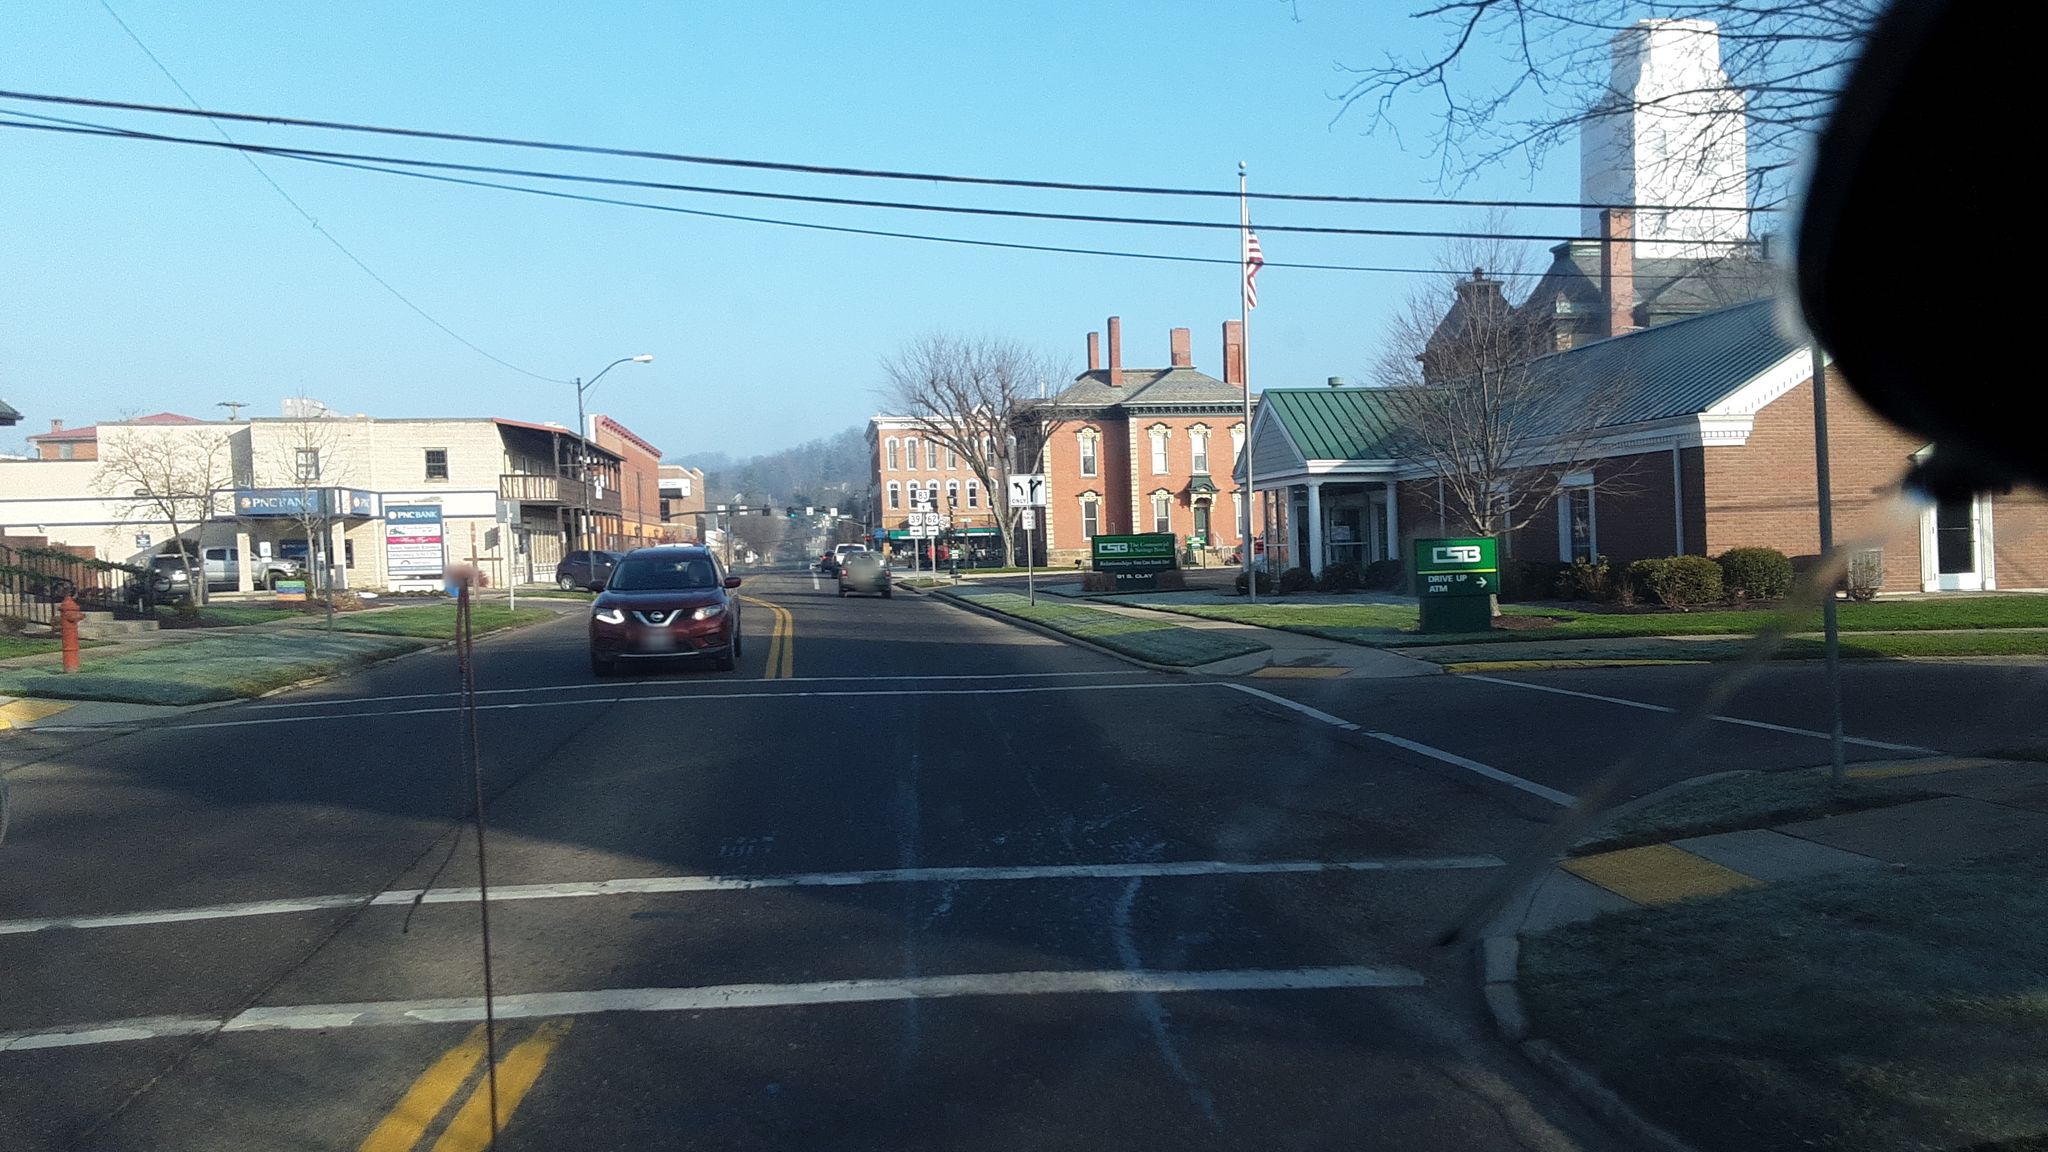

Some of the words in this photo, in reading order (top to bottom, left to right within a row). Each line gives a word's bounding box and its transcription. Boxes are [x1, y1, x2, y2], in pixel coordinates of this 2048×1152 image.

[918, 491, 928, 500] 83
[252, 498, 278, 508] PNC
[397, 511, 416, 519] PNC
[415, 511, 438, 519] BANK
[911, 515, 921, 524] 39
[927, 515, 937, 524] 62
[1098, 542, 1129, 554] CSB
[1432, 545, 1482, 564] CSB
[1427, 575, 1453, 583] DRIVE
[1456, 574, 1468, 582] UP
[1429, 584, 1448, 593] ATM
